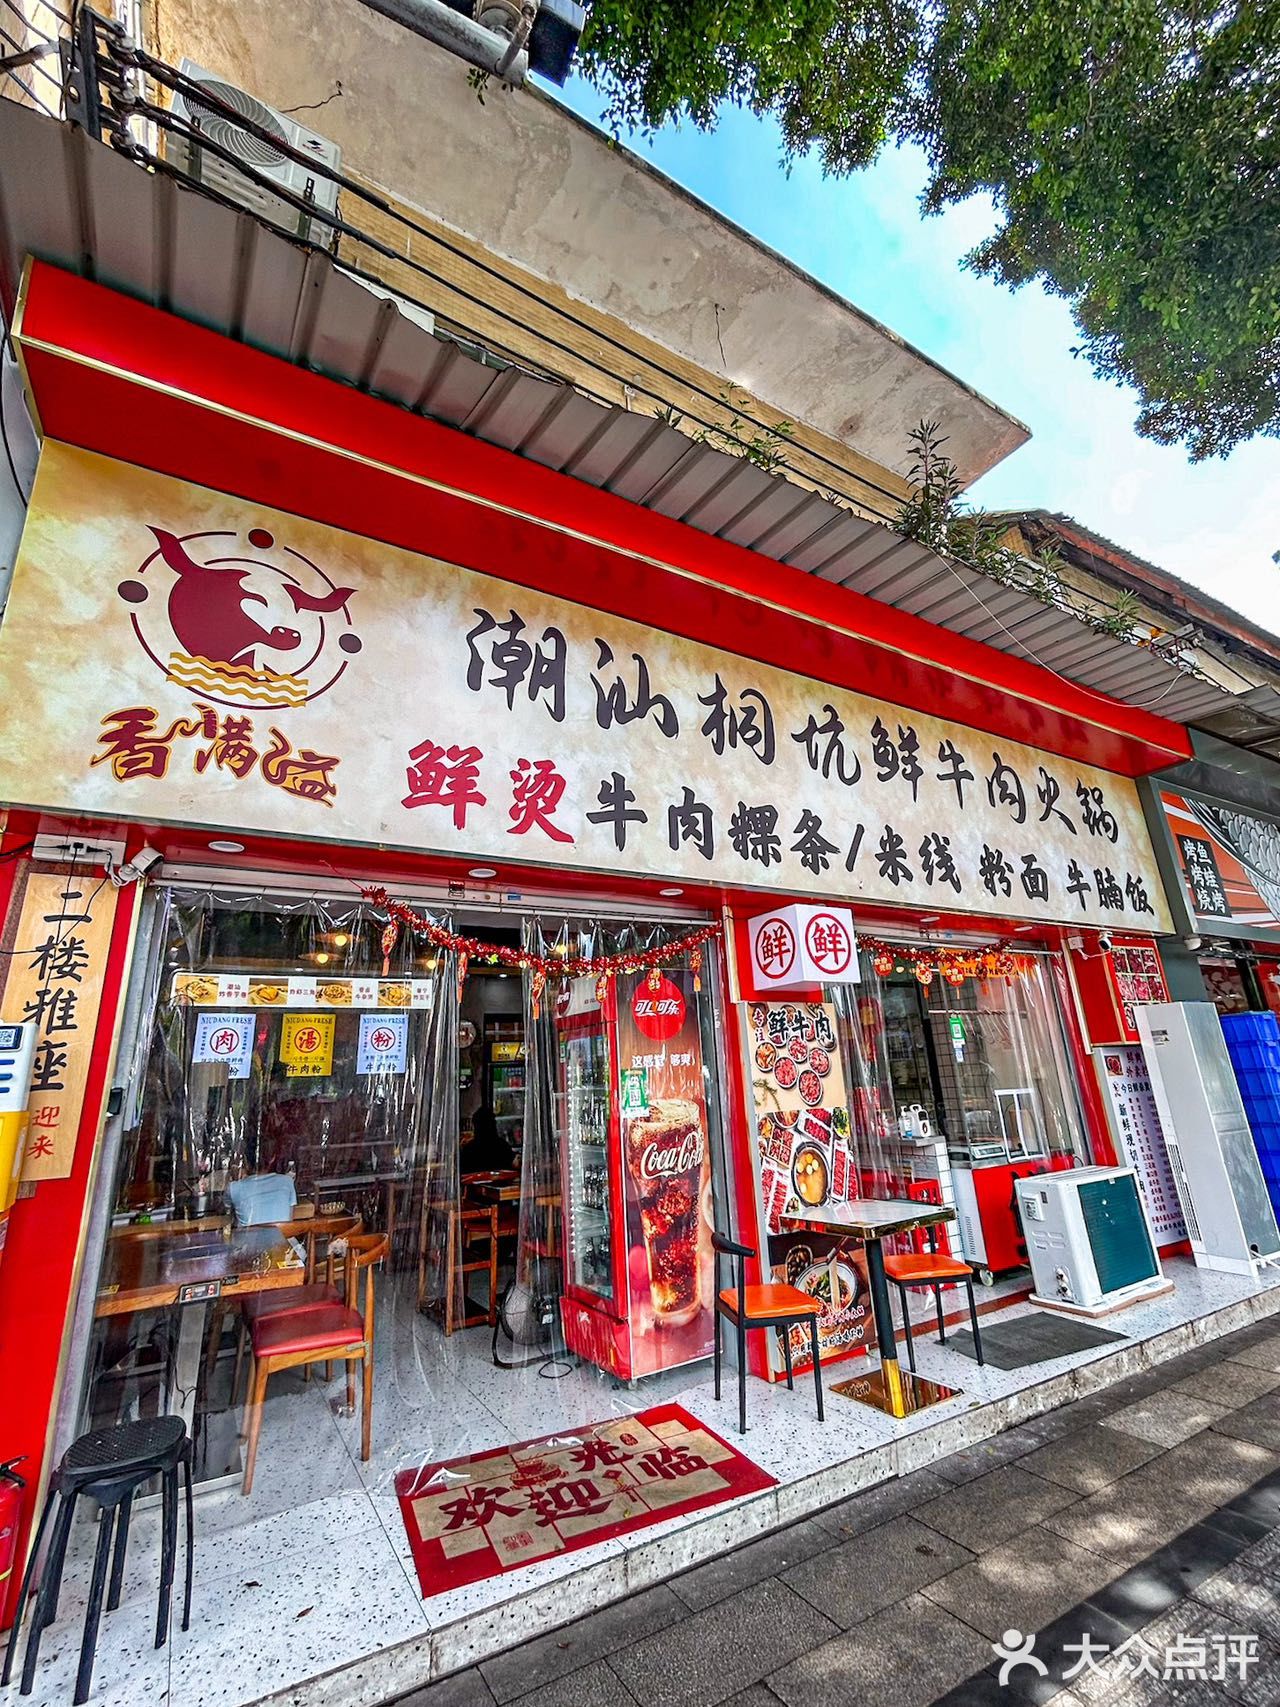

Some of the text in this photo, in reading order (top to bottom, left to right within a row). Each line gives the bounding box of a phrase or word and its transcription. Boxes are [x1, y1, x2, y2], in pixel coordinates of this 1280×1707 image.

[467, 608, 1119, 843] 潮汕桐坑鲜牛肉火锅
[401, 739, 574, 843] 鲜烫
[979, 843, 1049, 902] 粉面
[1066, 858, 1155, 916] 牛腩饭
[1183, 839, 1212, 864] 烤鱼
[1197, 887, 1226, 913] 烧烤
[761, 924, 791, 972] 鲜
[811, 921, 847, 966] 鲜
[21, 891, 93, 1092] 二楼雅座
[215, 1030, 234, 1053] 肉
[373, 1030, 392, 1048] 粉
[768, 1009, 832, 1041] 鲜牛肉
[26, 1106, 60, 1160] 迎来
